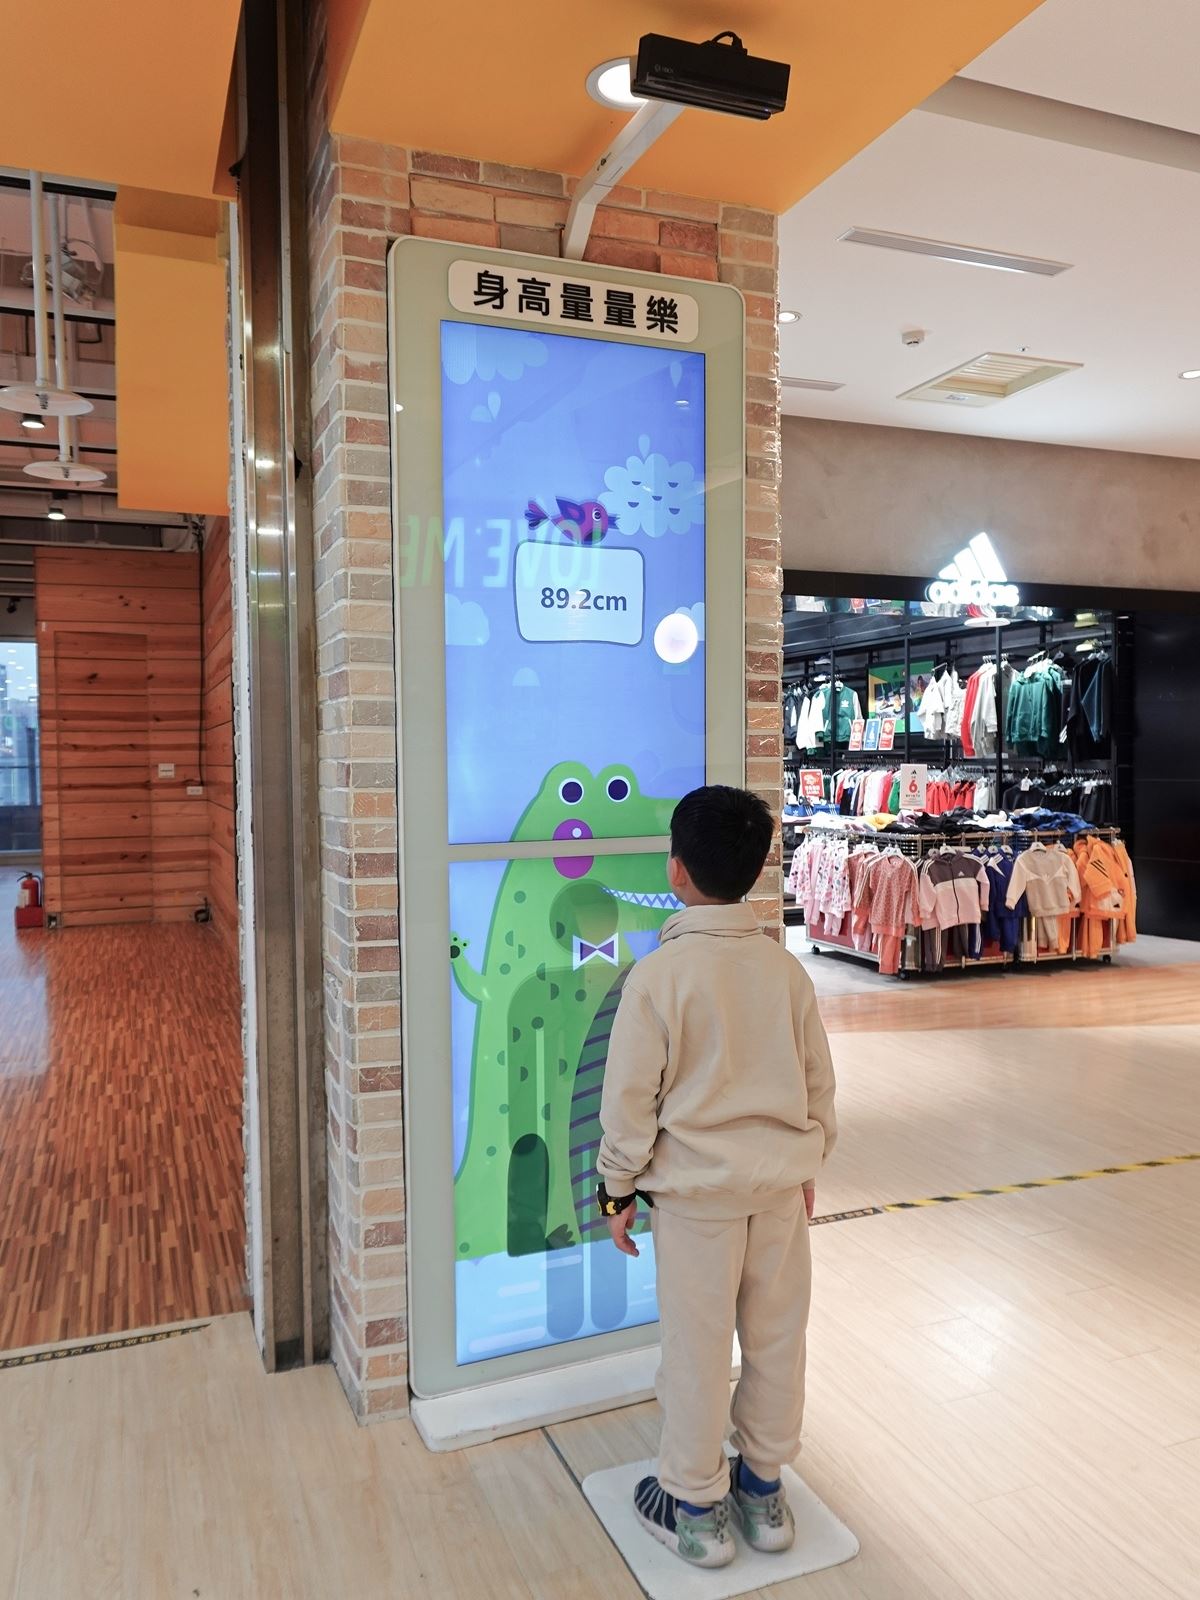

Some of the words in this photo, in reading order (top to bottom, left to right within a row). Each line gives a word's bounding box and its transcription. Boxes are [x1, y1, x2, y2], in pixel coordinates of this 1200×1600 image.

[473, 270, 679, 334] 身高量量樂
[541, 587, 628, 612] 89.2cm
[926, 579, 1020, 607] adidas
